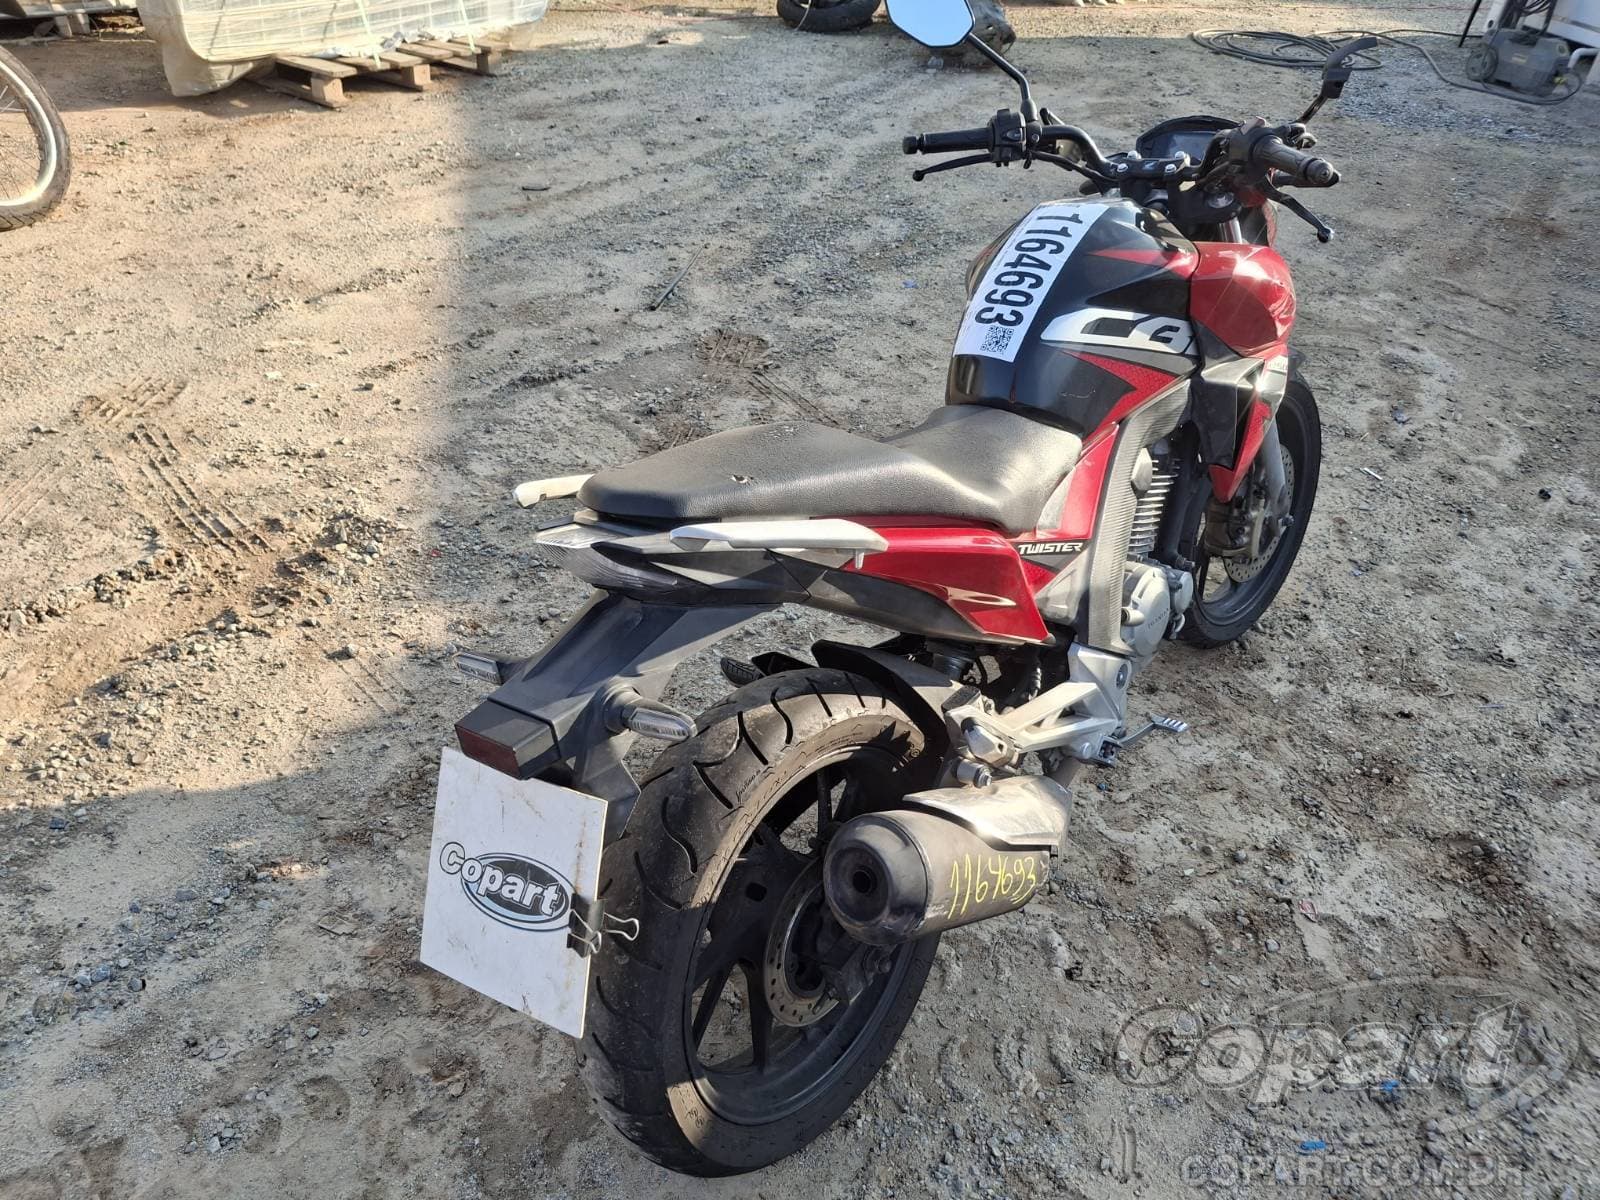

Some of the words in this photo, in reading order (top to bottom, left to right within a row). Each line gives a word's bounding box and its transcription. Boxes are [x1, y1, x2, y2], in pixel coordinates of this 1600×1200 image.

[975, 212, 1083, 327] 1164693
[1018, 542, 1084, 555] TWISTER
[439, 841, 561, 917] Copart
[947, 853, 1037, 920] 1164693
